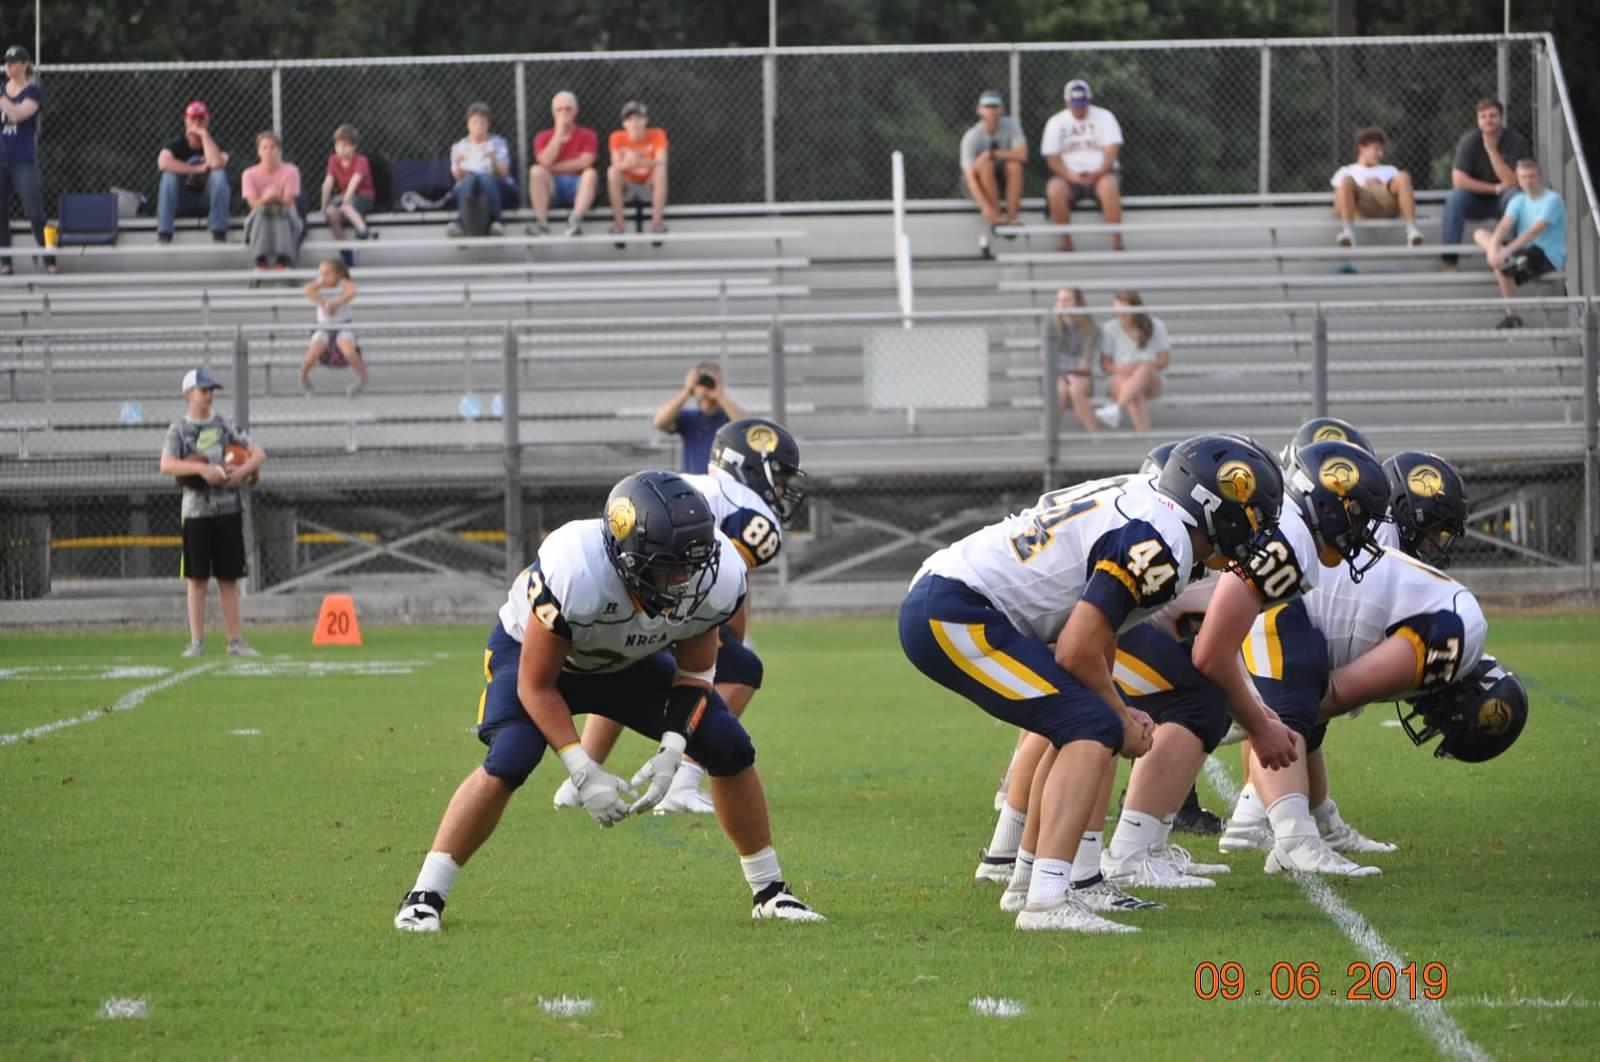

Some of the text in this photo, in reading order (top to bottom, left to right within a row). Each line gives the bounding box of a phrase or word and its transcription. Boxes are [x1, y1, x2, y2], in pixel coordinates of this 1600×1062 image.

[742, 515, 779, 560] 88
[1127, 539, 1176, 596] 44
[1251, 540, 1298, 598] 60
[326, 610, 350, 636] 20
[624, 632, 667, 647] NRCA
